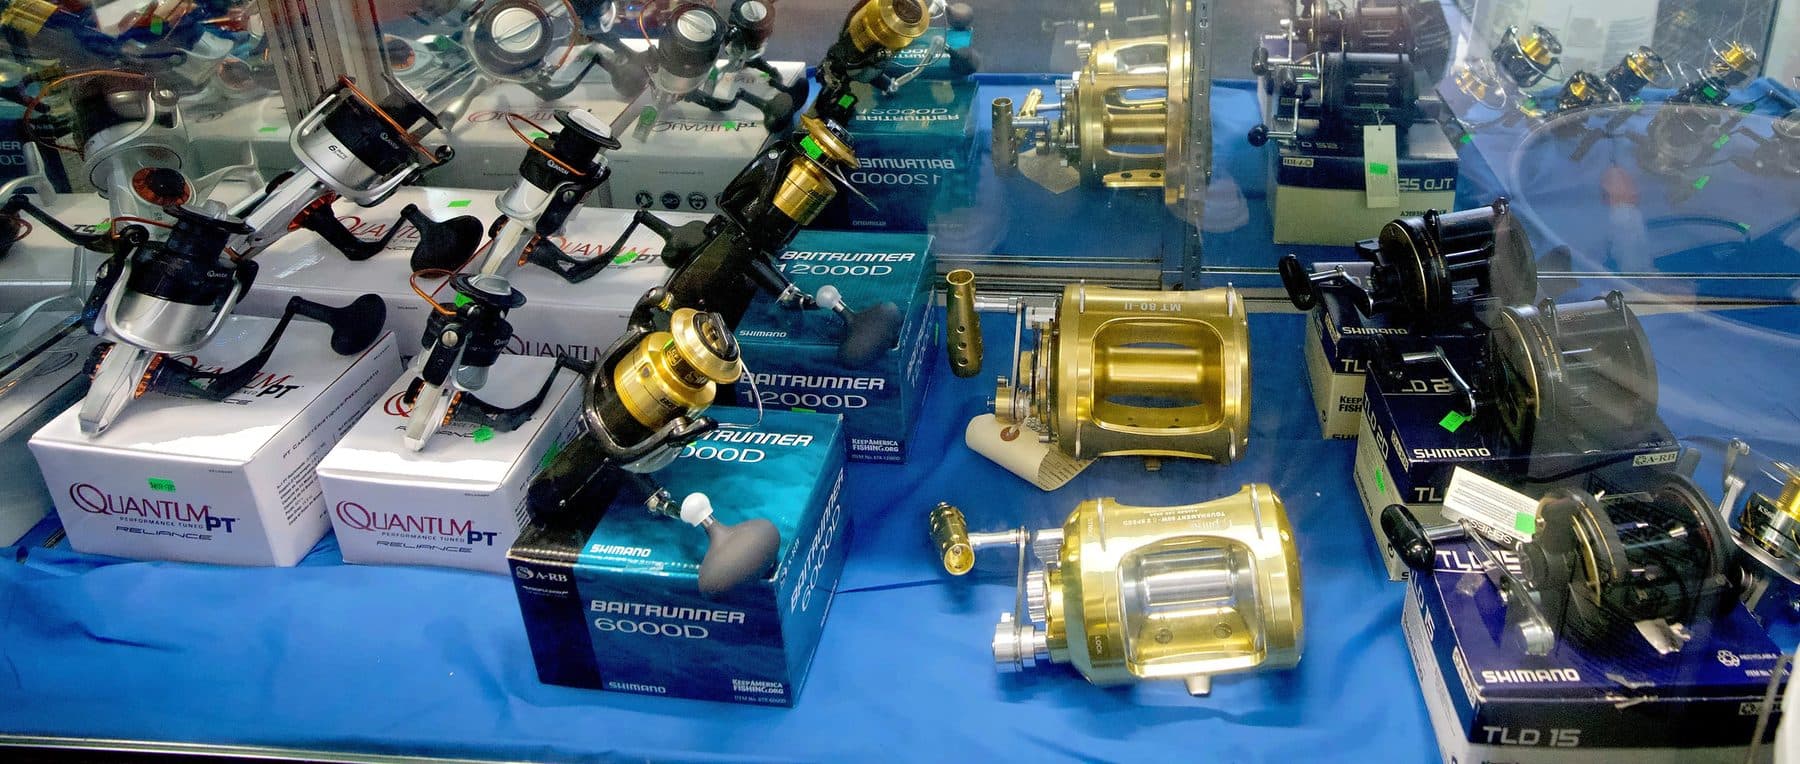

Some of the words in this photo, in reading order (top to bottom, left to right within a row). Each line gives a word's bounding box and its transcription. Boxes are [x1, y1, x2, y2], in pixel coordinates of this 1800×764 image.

[780, 251, 917, 262] BAITRUNNER
[776, 264, 893, 276] 12000D
[1160, 303, 1182, 312] MT
[738, 330, 788, 338] SHIMANO
[1341, 326, 1409, 335] SHIMANO
[1341, 359, 1366, 372] TL
[740, 372, 886, 390] BAITRUNNER
[255, 384, 300, 399] PT
[741, 390, 868, 408] 12000D
[1413, 448, 1492, 459] SHIMANO
[1414, 487, 1448, 501] TL
[69, 482, 209, 522] QUANTUM
[205, 516, 237, 533] PT
[335, 500, 472, 537] QUANTUM
[467, 530, 498, 547] PT
[115, 525, 213, 541] RELIANCE
[381, 532, 437, 541] PERFORMANCE
[376, 540, 473, 553] RELIANCE
[790, 467, 845, 614] BAITRUNNER
[590, 543, 652, 557] SHIMANO
[590, 599, 746, 625] BAITRUNNER
[594, 617, 709, 639] 6000D
[1481, 668, 1581, 683] SHIMANO
[608, 681, 667, 694] SHIMANO
[1482, 725, 1540, 746] TLD
[1549, 727, 1582, 747] 15
